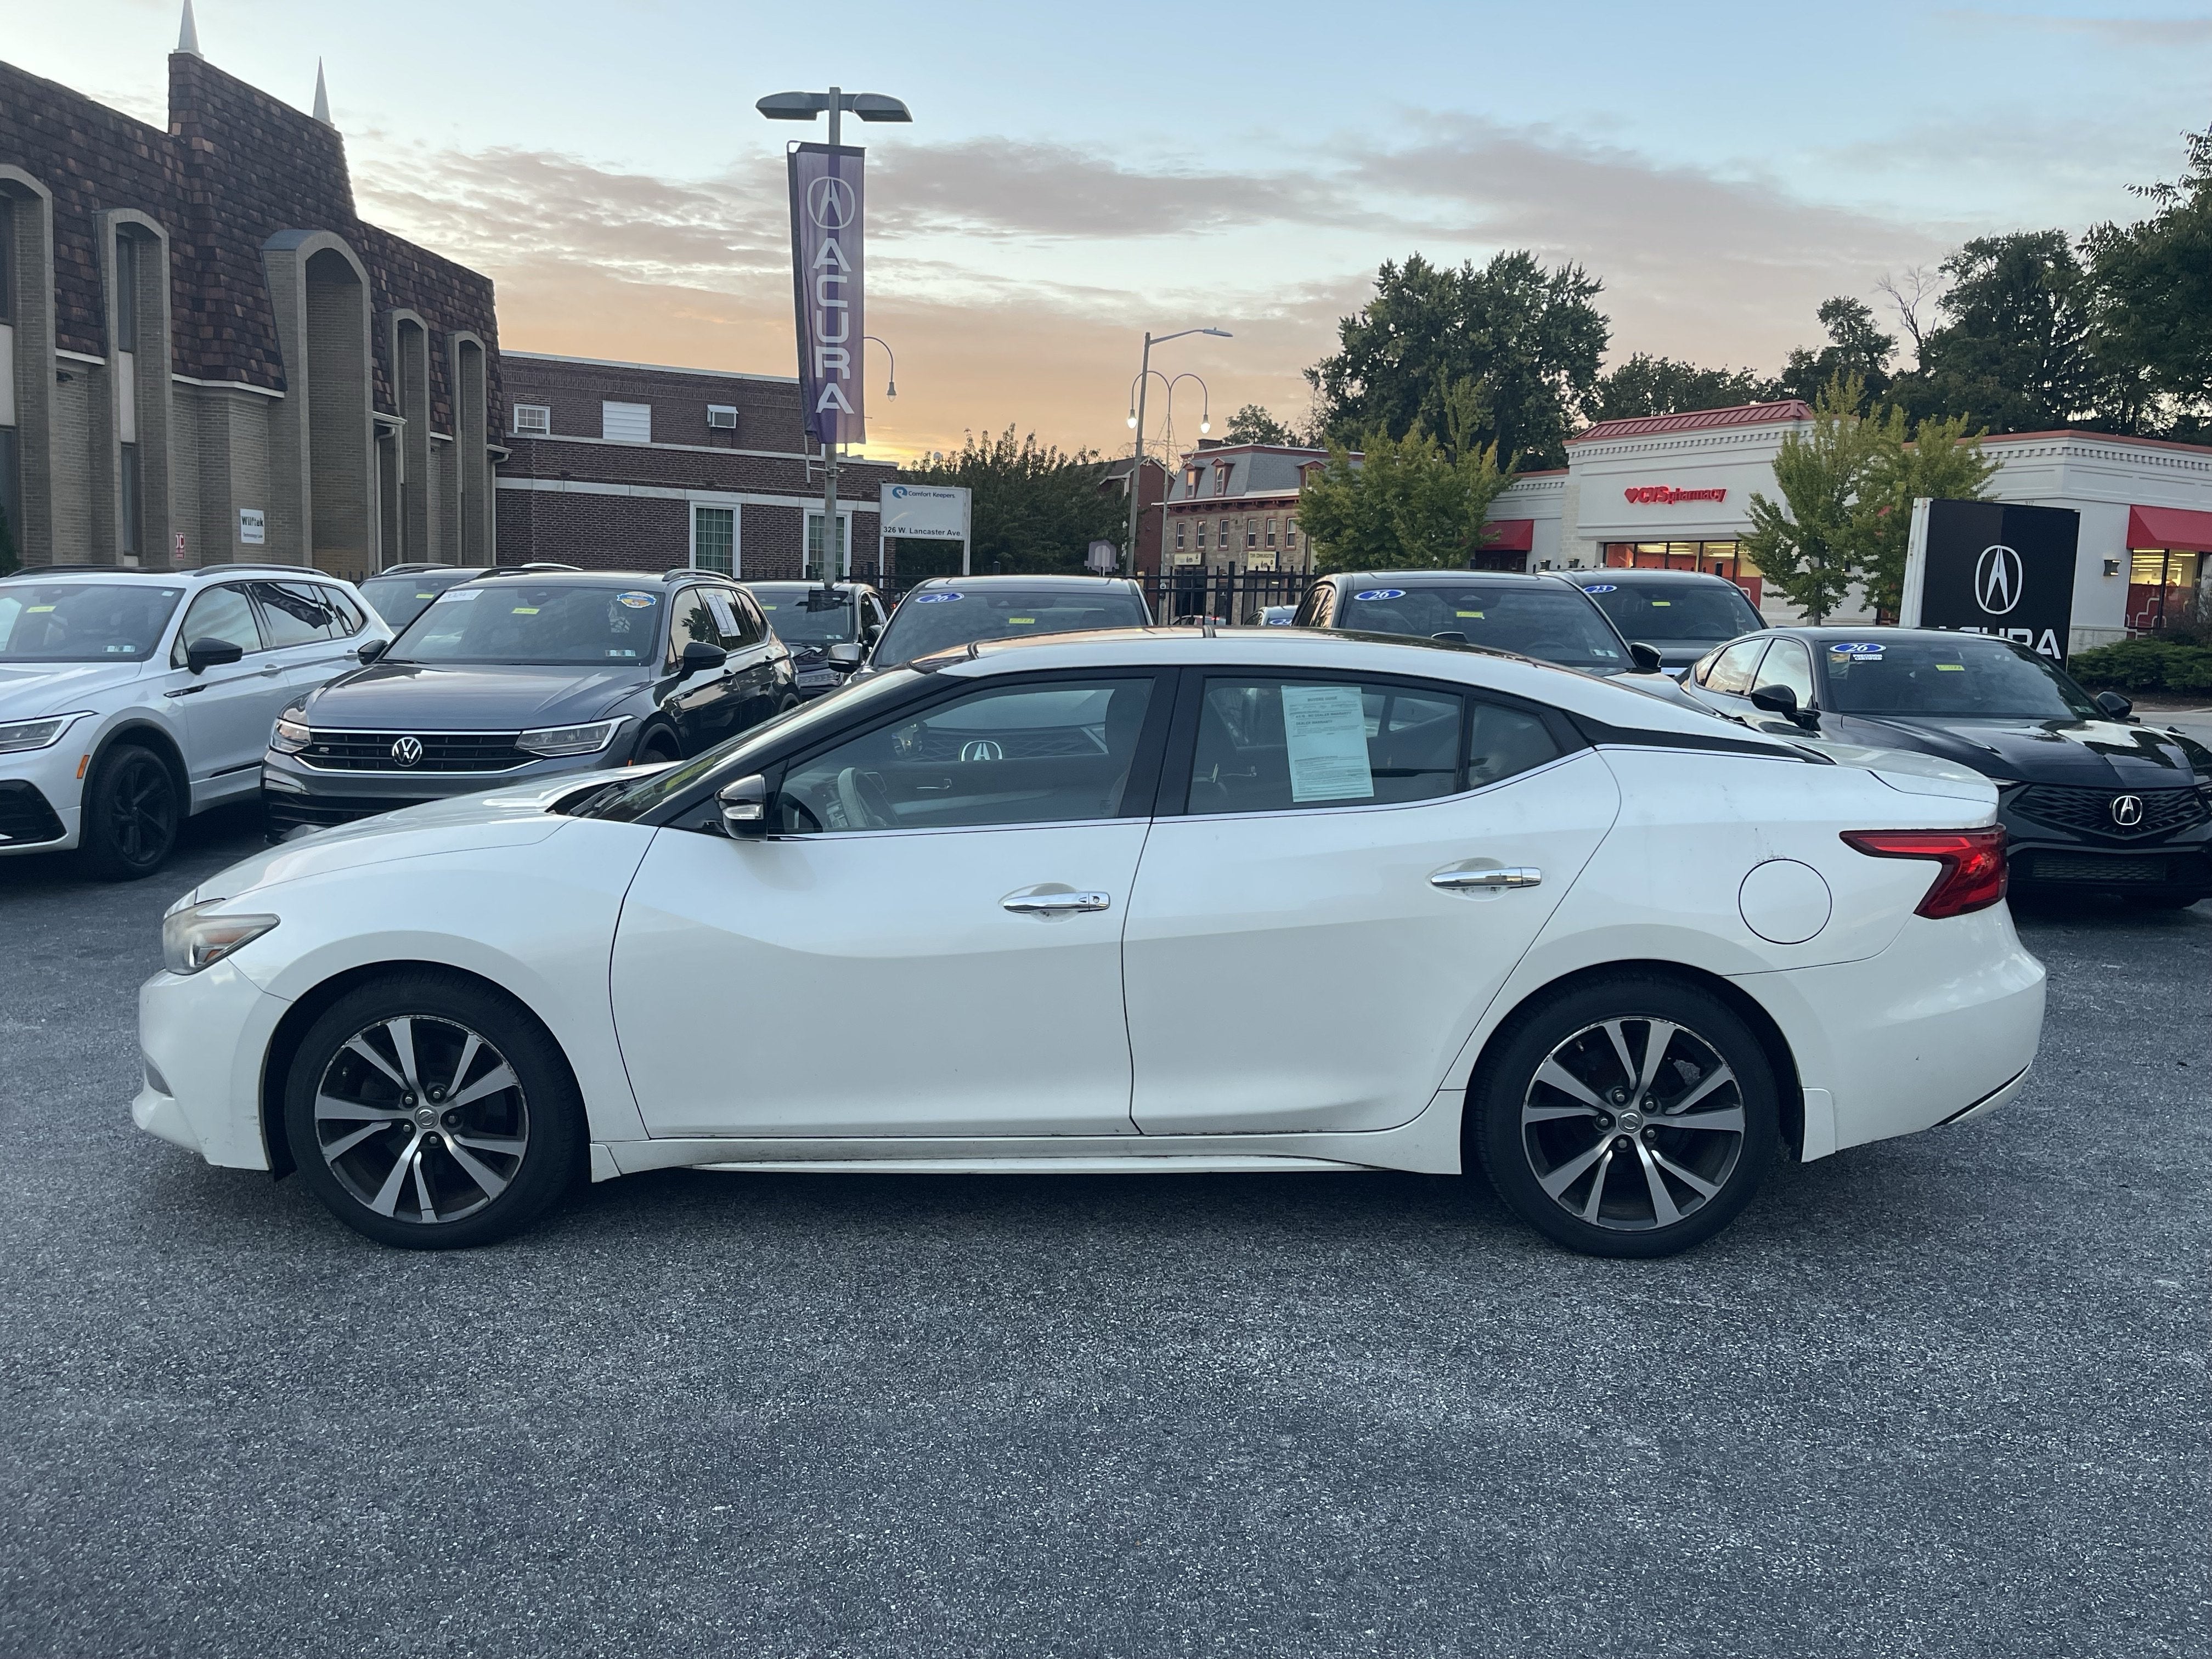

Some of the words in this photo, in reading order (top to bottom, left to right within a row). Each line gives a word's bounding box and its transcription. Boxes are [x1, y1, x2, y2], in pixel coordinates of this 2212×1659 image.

[812, 238, 855, 414] ACURA
[910, 527, 945, 535] Lancaster
[927, 594, 951, 602] 26
[1368, 590, 1390, 600] 26
[1846, 644, 1869, 652] 26
